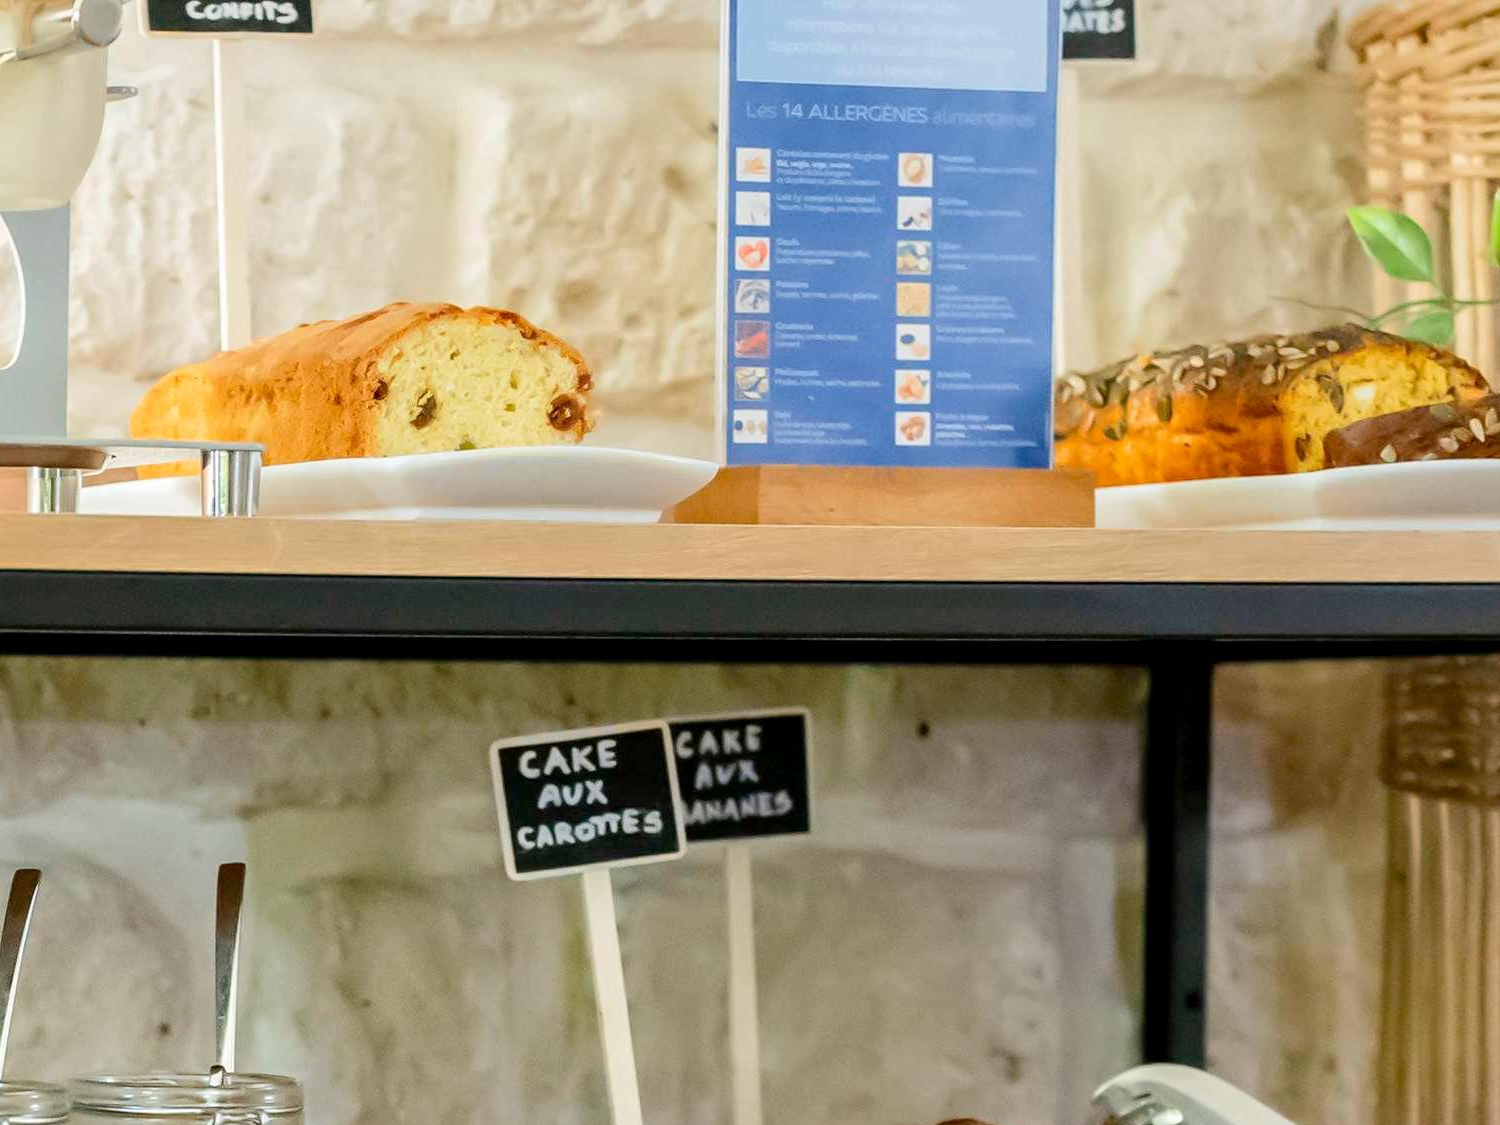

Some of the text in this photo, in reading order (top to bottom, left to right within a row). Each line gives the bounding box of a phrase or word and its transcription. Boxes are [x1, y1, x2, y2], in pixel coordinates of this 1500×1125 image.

[185, 0, 299, 24] CONFITS
[745, 101, 777, 119] Les
[782, 102, 804, 119] 14
[675, 724, 763, 759] CAKE
[519, 739, 618, 779] CAKE
[694, 760, 759, 790] AUX
[538, 780, 609, 809] AUX
[682, 789, 793, 825] ANANES
[517, 808, 664, 851] CAROTTES
